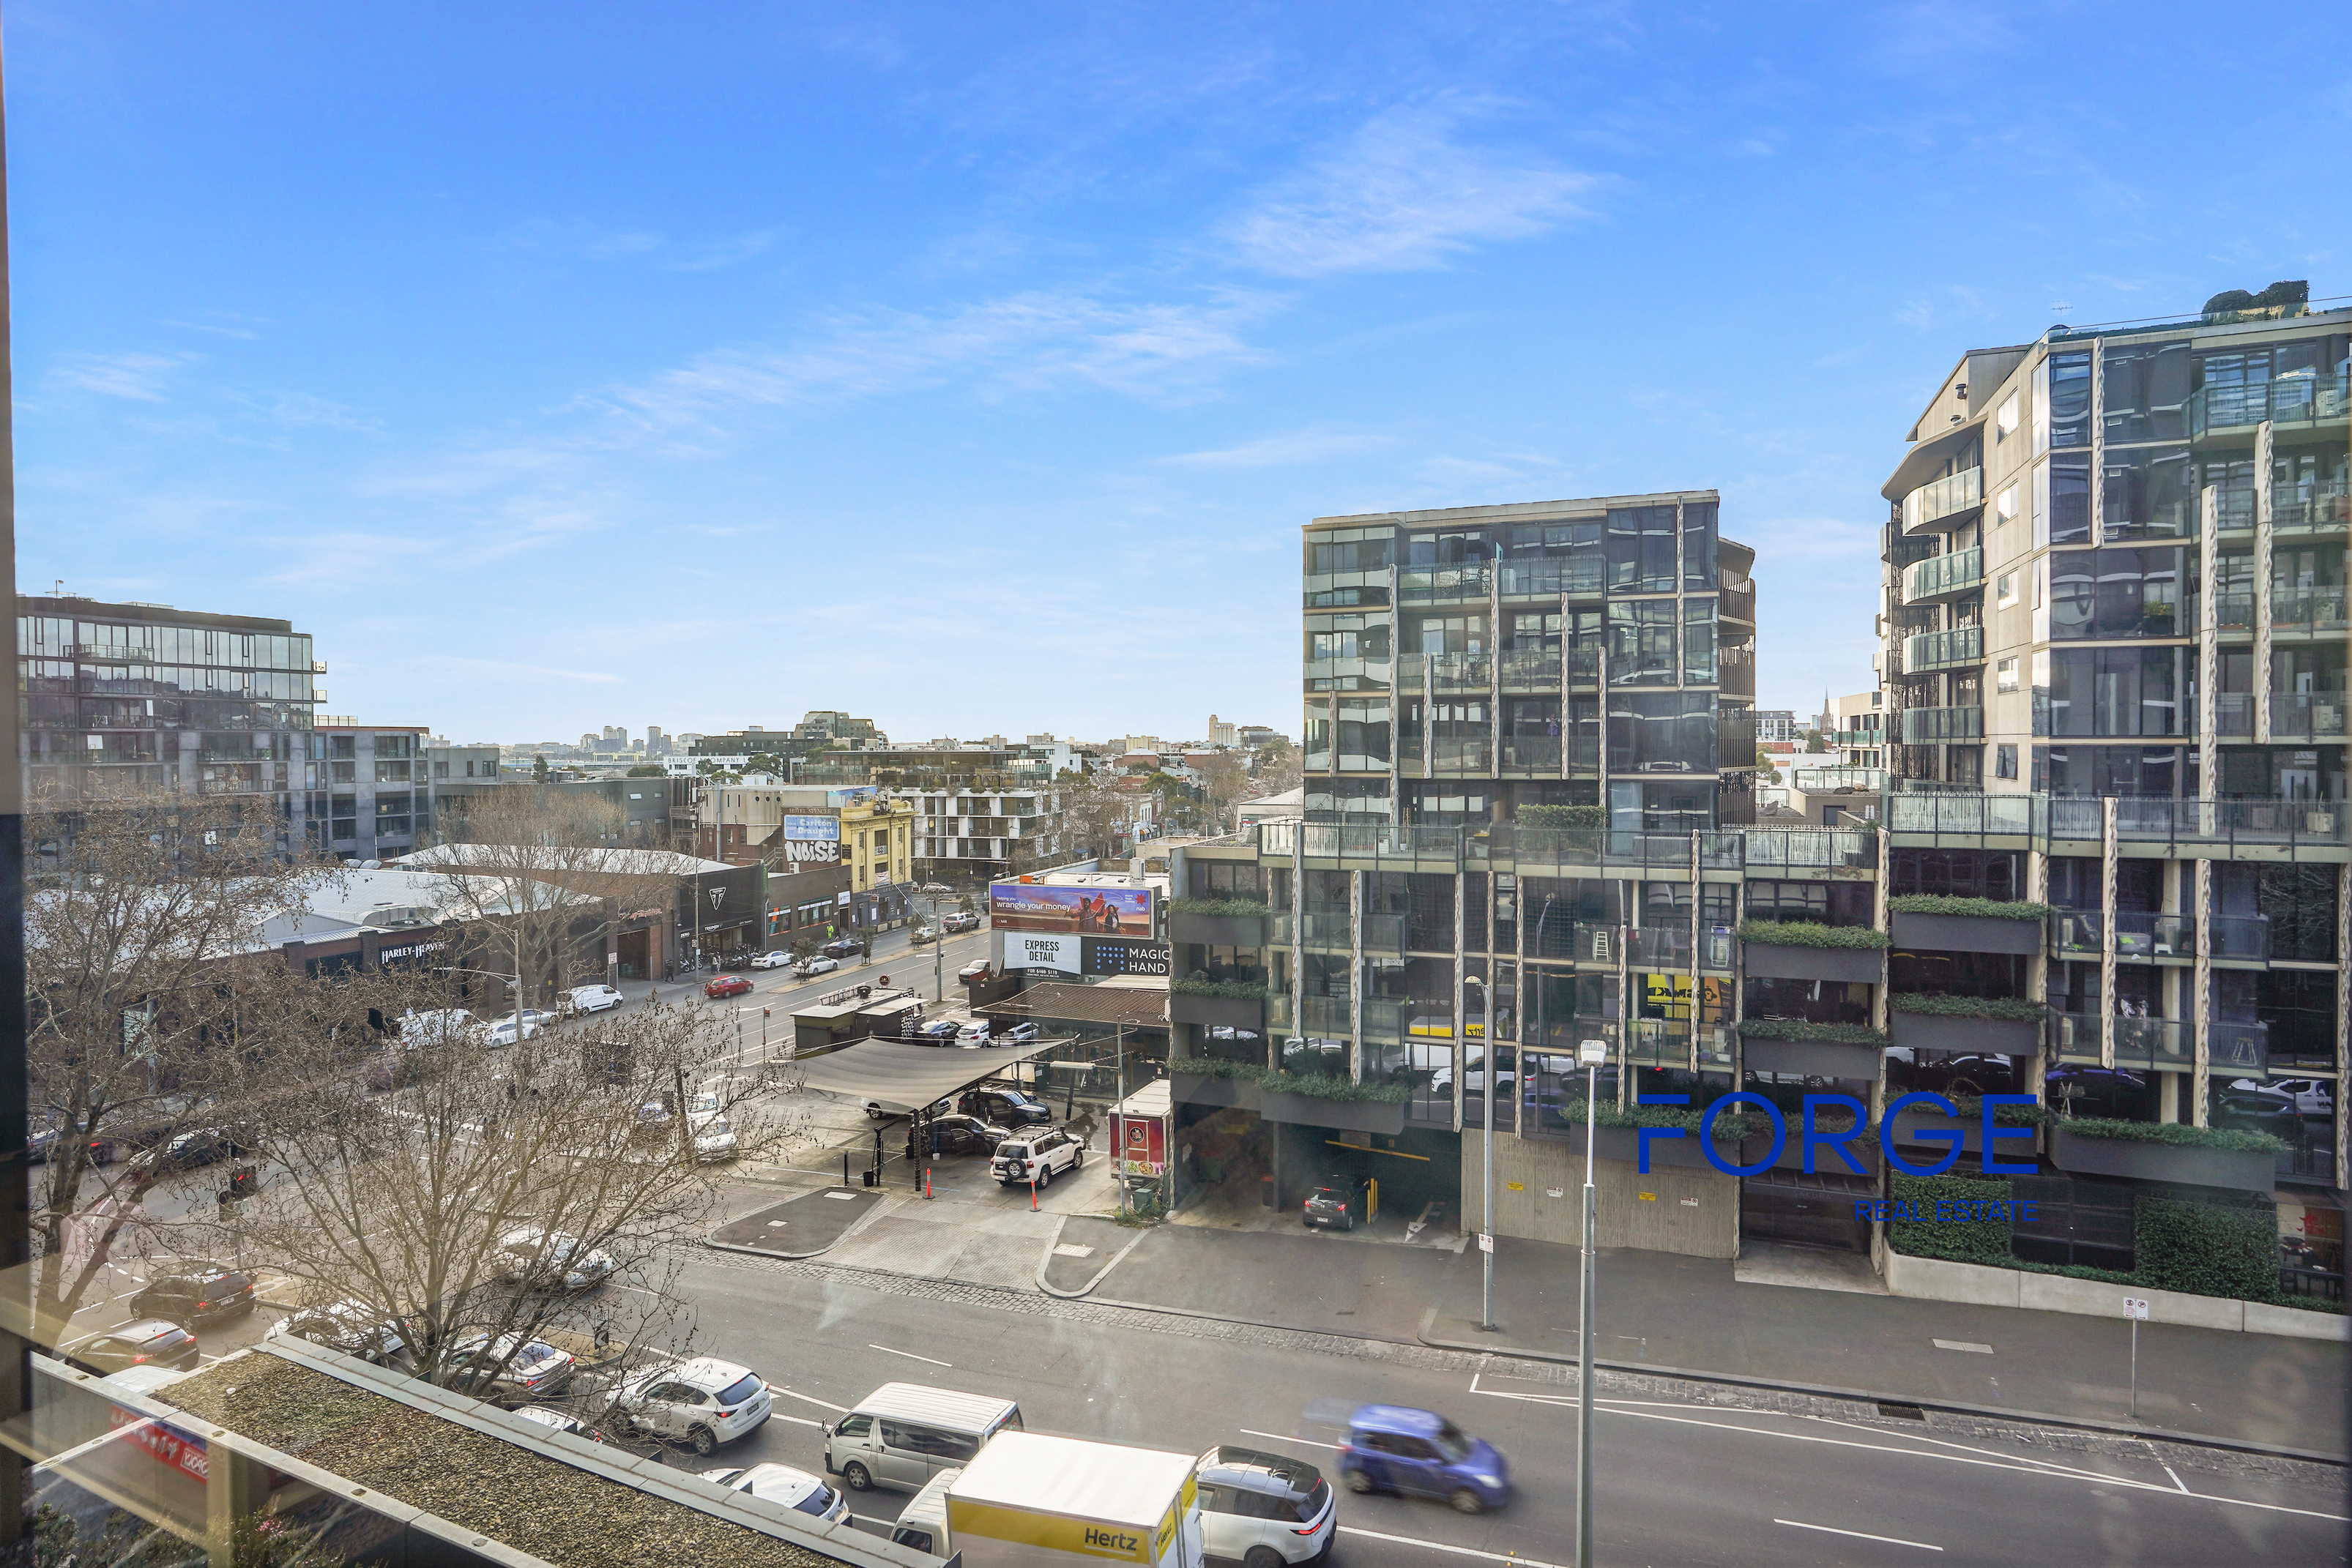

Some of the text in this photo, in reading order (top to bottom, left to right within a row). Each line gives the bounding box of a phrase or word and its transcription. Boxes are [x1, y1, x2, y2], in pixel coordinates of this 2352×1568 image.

[799, 818, 832, 827] Carlton
[797, 827, 834, 838] Draught
[997, 901, 1025, 910] wrangle
[1046, 904, 1071, 912] money
[1025, 940, 1059, 952] EXPRESS
[1029, 952, 1055, 963] DETAIL
[1129, 948, 1169, 960] MAGIC
[1129, 961, 1166, 974] HAND
[1085, 1528, 1138, 1551] Hertz
[1161, 1522, 1172, 1547] Hertz
